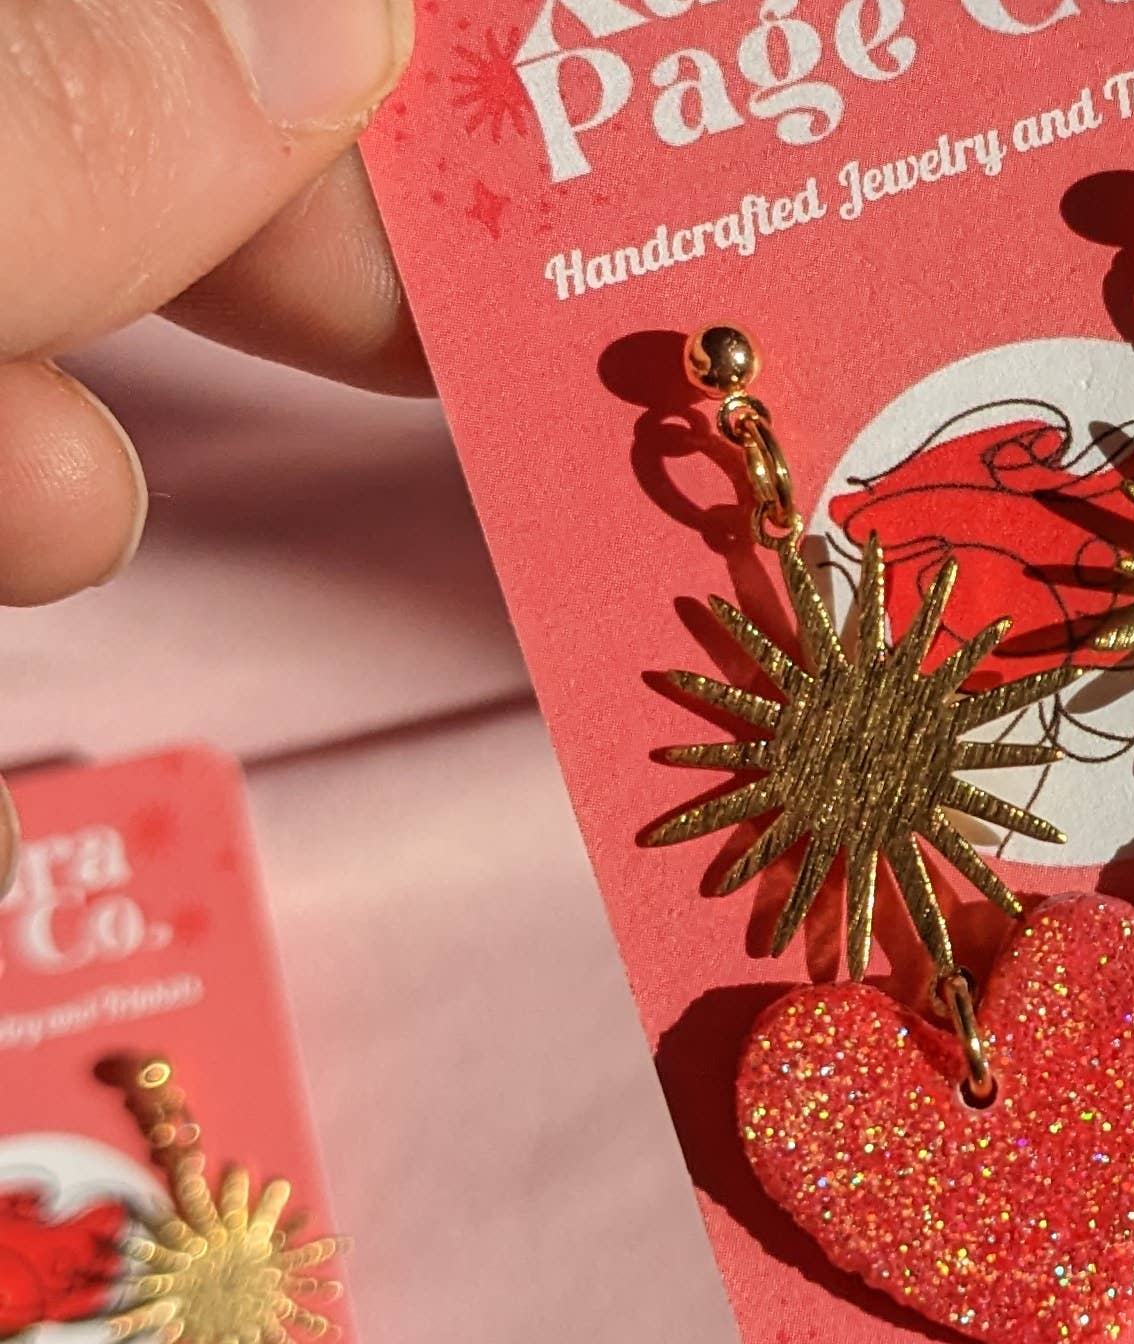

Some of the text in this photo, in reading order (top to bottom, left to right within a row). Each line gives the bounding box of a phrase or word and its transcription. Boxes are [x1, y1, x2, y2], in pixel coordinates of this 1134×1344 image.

[544, 176, 826, 301] Handcrafted
[838, 128, 1007, 221] Jewelry
[1012, 86, 1102, 153] and
